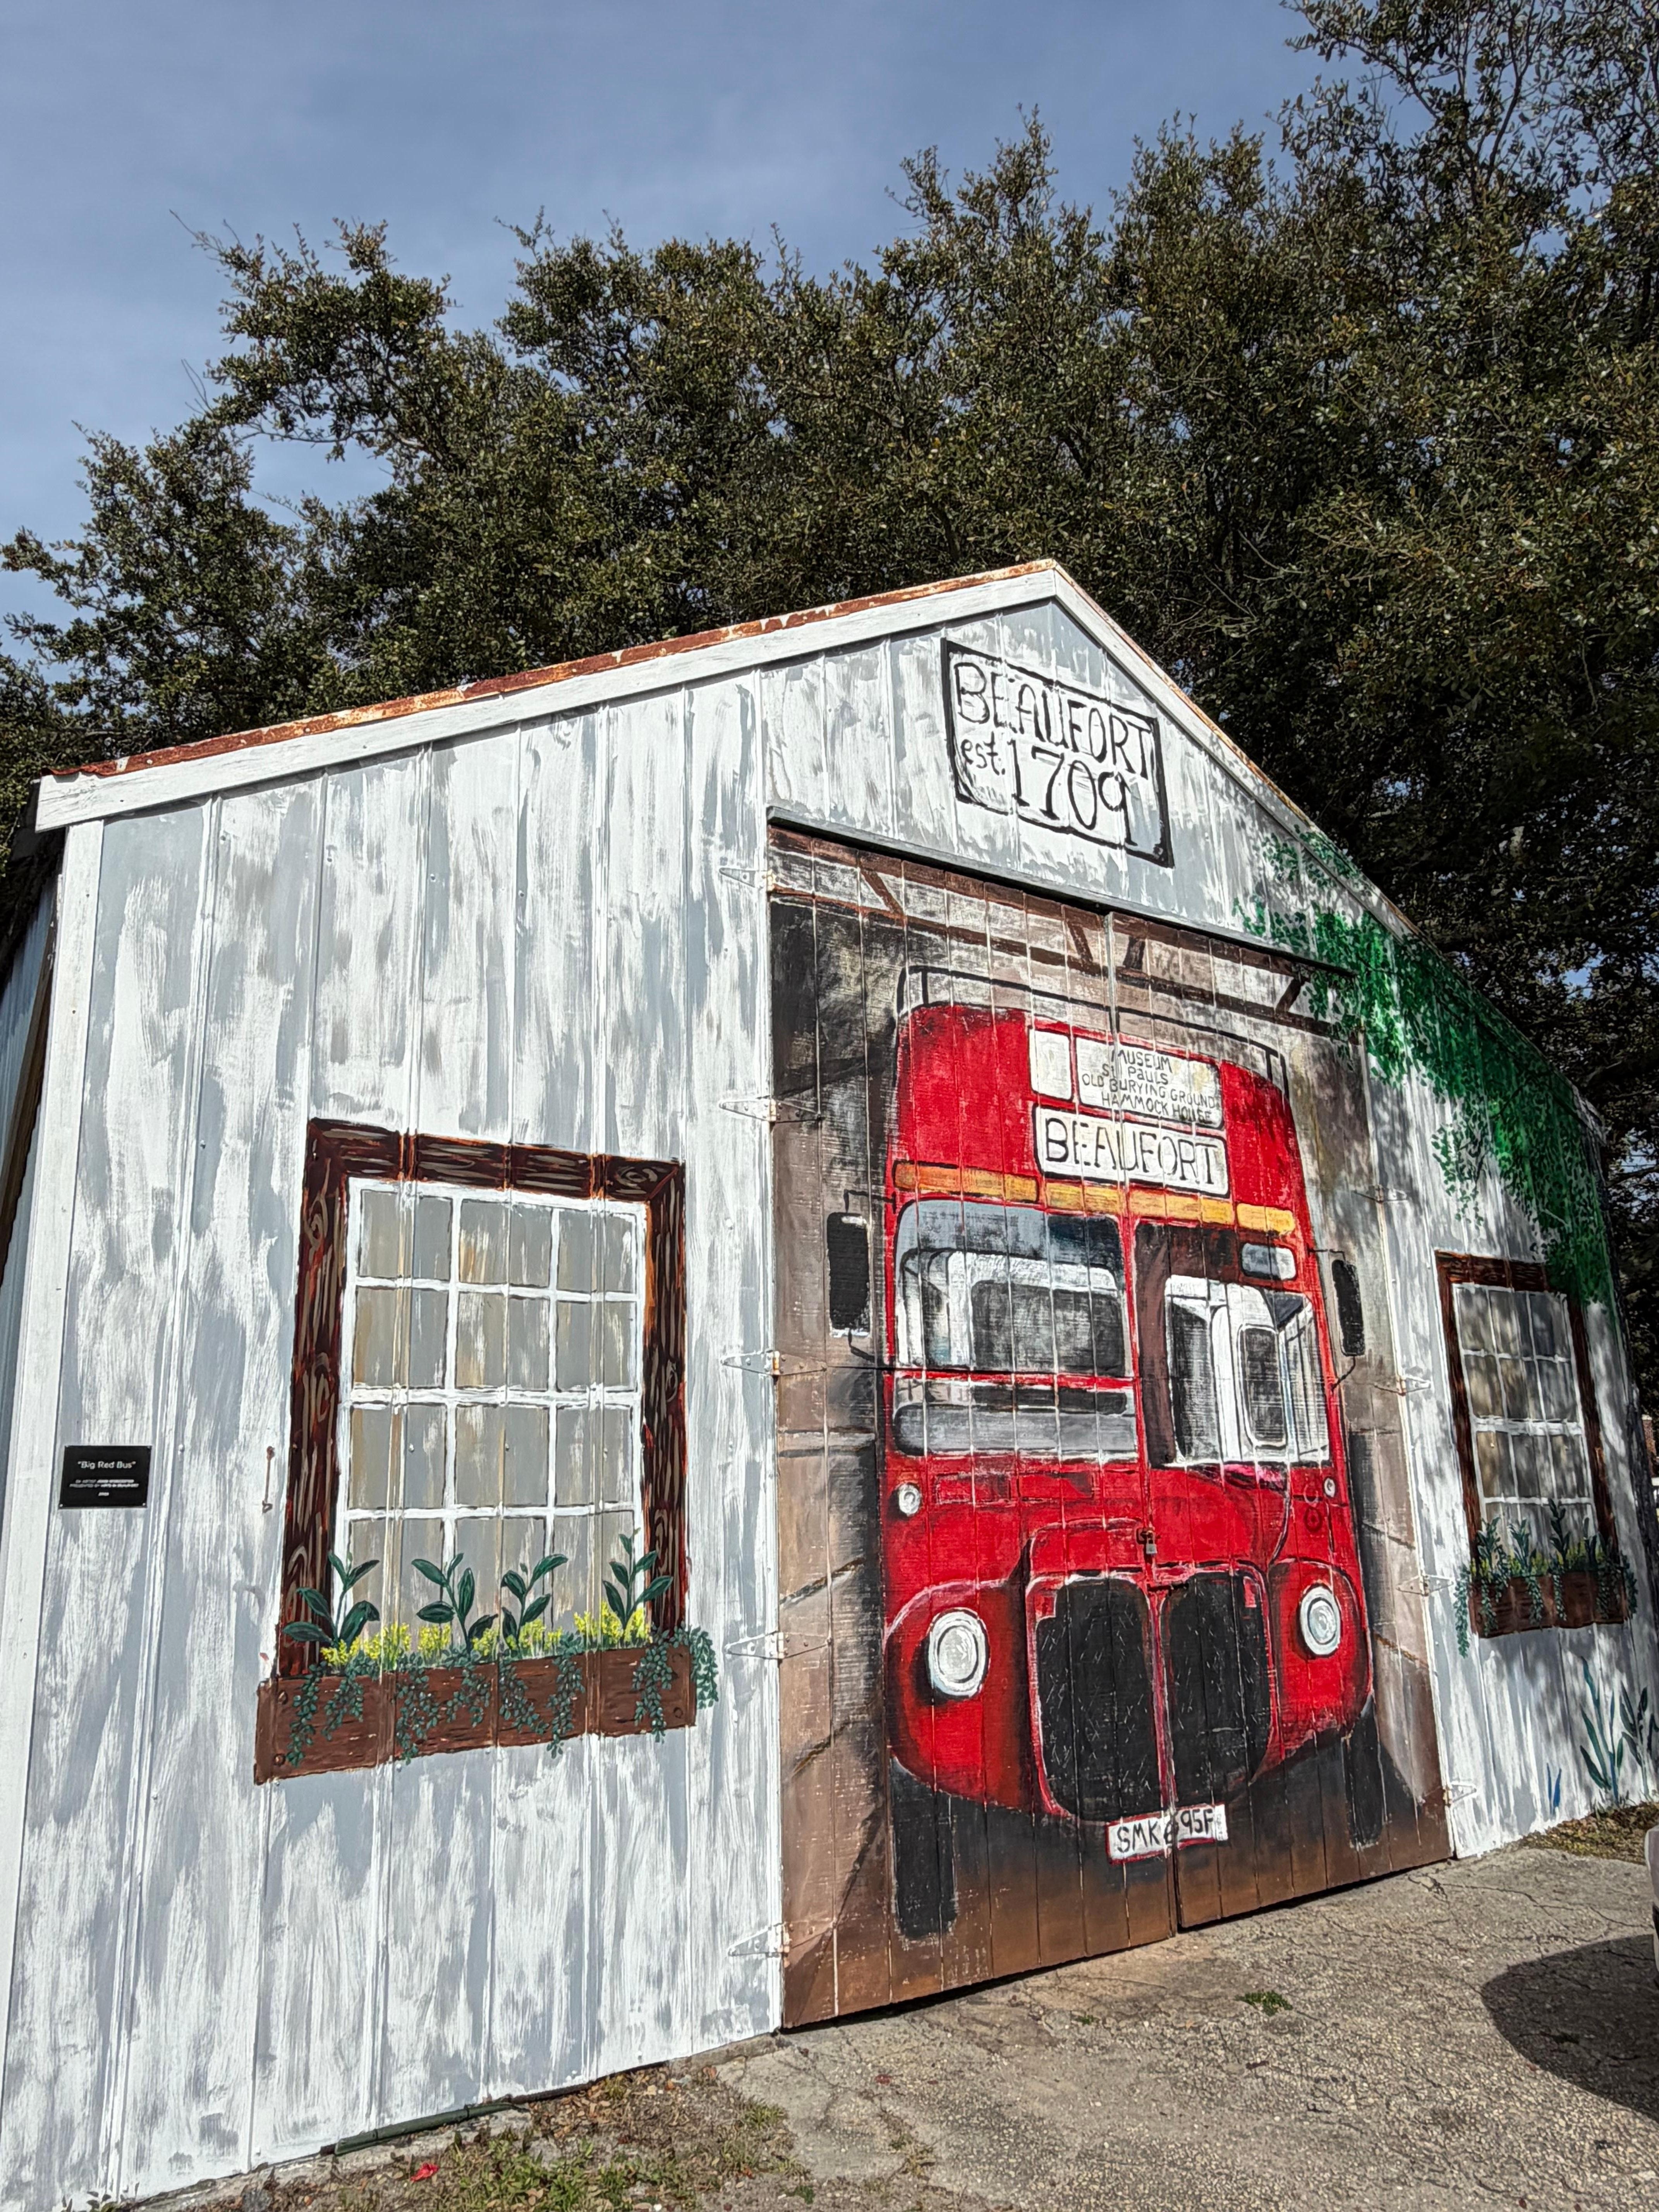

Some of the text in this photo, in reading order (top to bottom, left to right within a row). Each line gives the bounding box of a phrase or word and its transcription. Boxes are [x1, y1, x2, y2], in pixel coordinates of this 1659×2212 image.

[954, 662, 1152, 779] BEAUFORT
[960, 732, 1138, 846] est. 1709
[1111, 1050, 1173, 1073] MUSEUM
[1082, 1073, 1216, 1108] OLD BURYING GROUND
[1101, 1091, 1213, 1122] HAMMOCK HOUSE
[1045, 1117, 1219, 1184] BEAUFORT
[98, 1461, 115, 1469] Red
